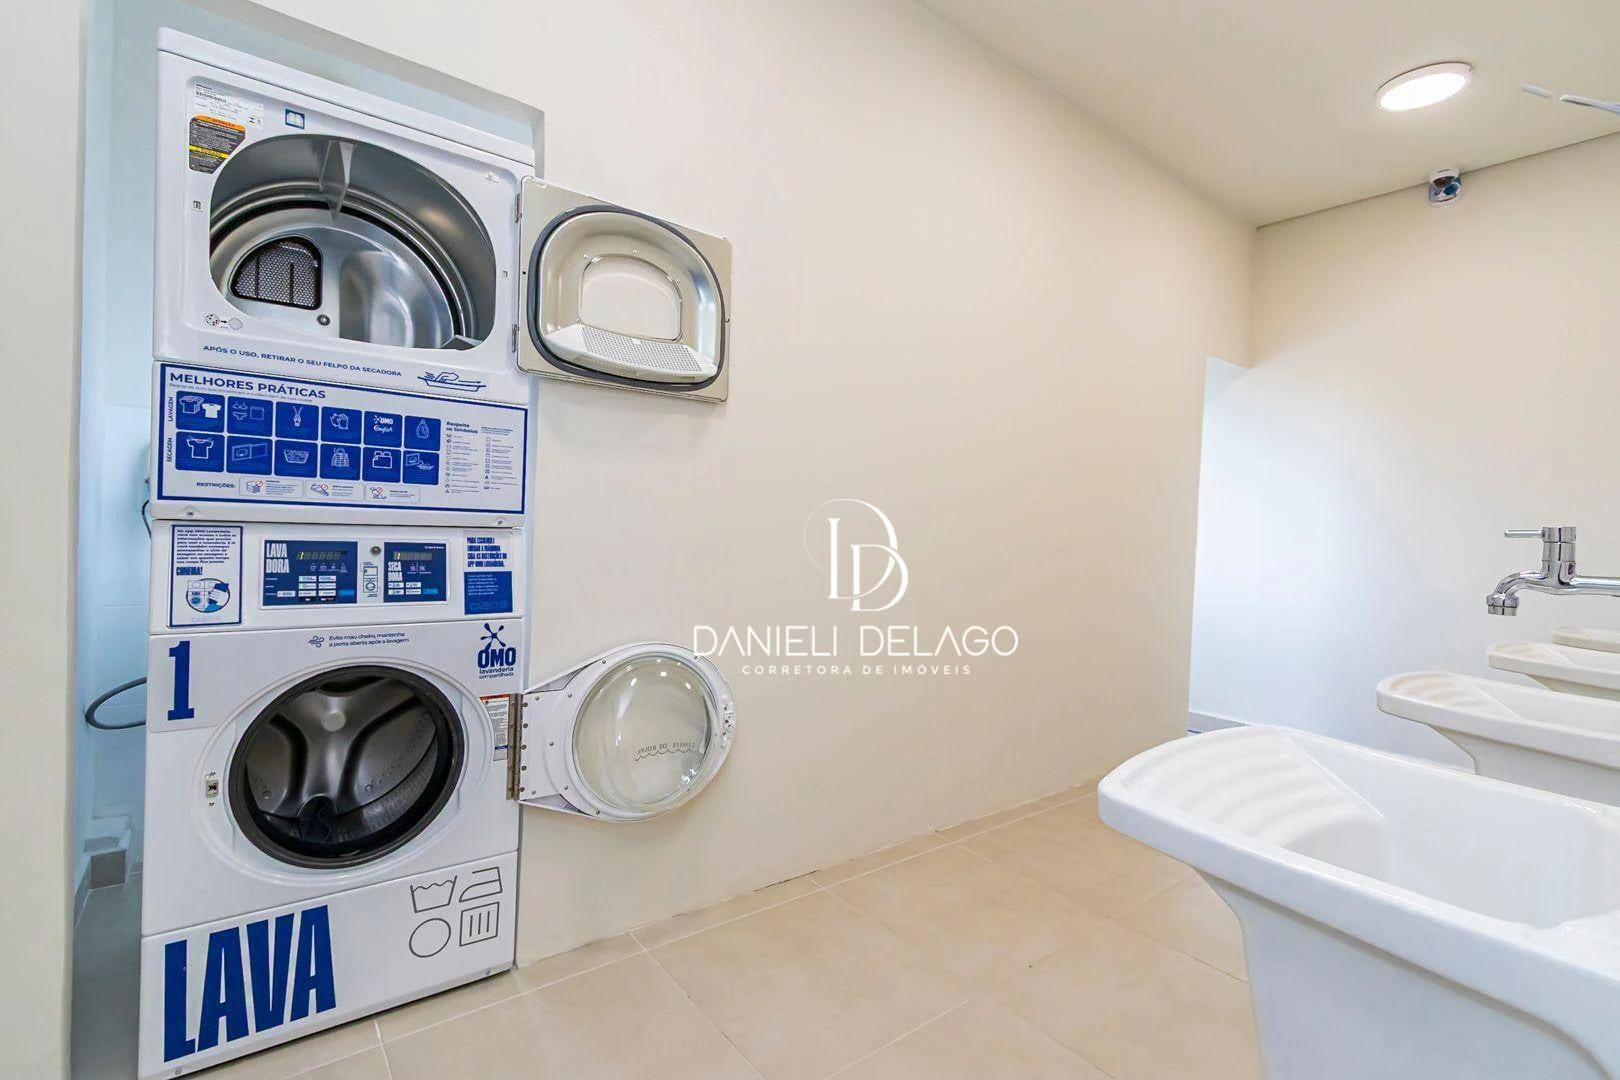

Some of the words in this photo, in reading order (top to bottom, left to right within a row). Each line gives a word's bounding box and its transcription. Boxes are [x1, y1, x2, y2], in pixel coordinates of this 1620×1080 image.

[203, 345, 228, 354] APÓS
[239, 350, 259, 358] USO,
[261, 353, 296, 362] RETIRAR
[363, 367, 402, 376] SECADORA
[170, 373, 254, 390] MELHORES
[258, 383, 326, 398] PRÁTICAS
[266, 543, 287, 557] LAVA
[266, 559, 290, 573] DORA
[478, 647, 516, 668] OMO
[168, 640, 195, 721] 1
[479, 666, 514, 674] lavanderia
[163, 904, 336, 1063] LAVA
